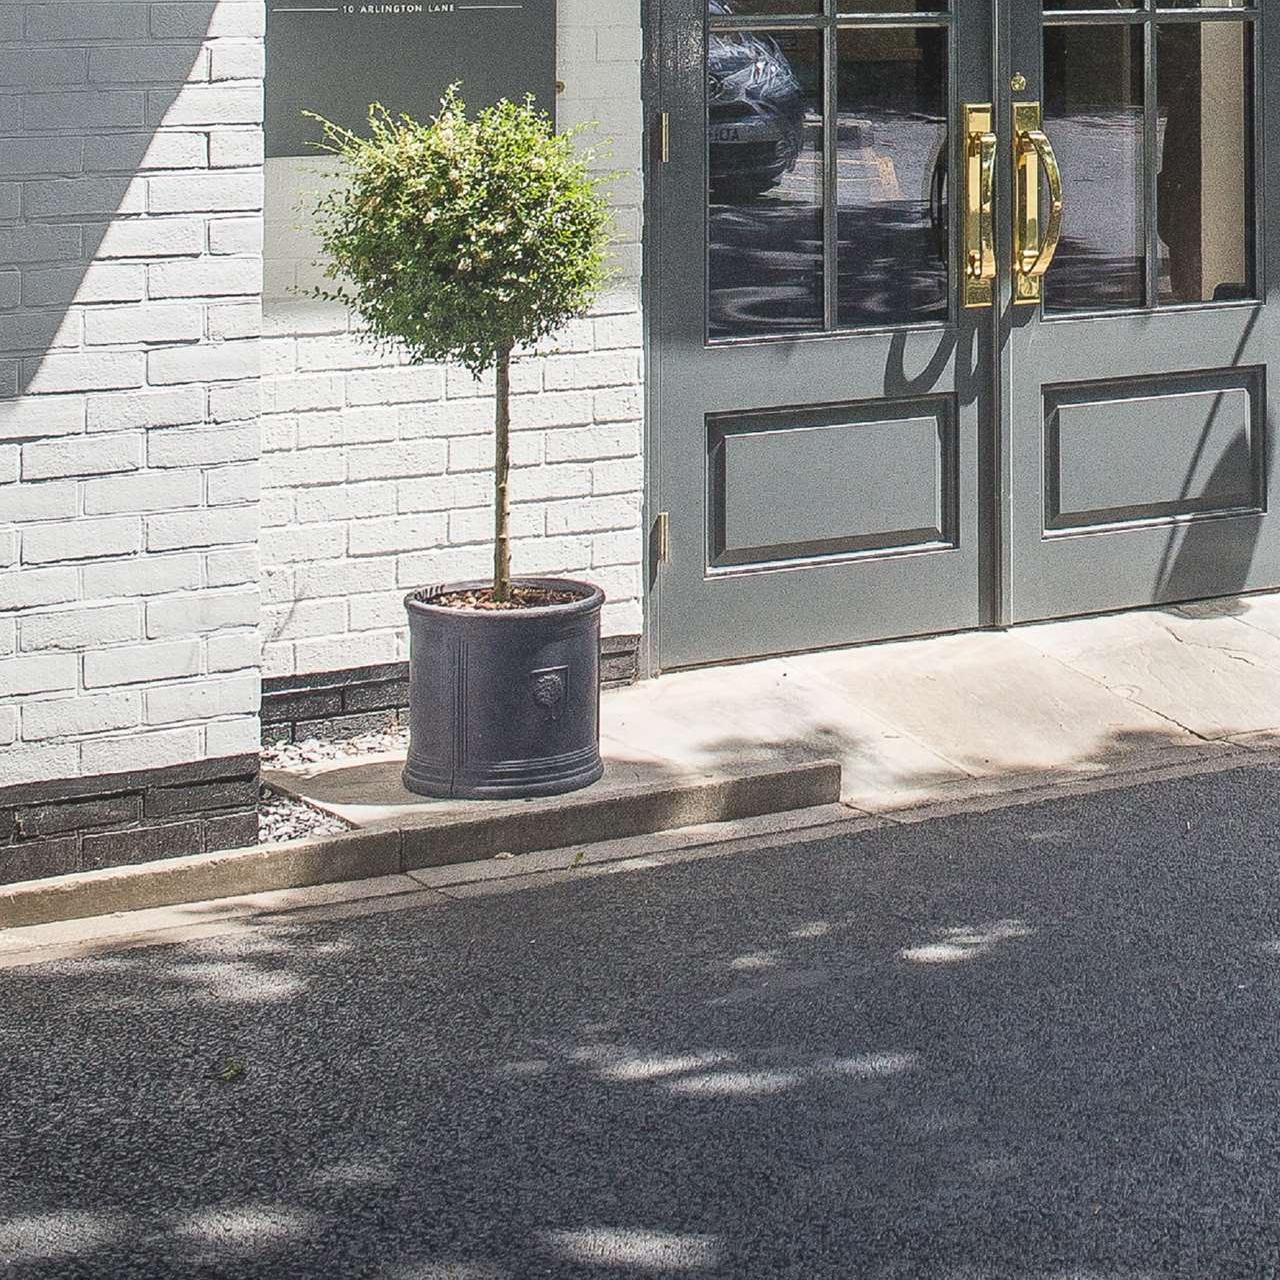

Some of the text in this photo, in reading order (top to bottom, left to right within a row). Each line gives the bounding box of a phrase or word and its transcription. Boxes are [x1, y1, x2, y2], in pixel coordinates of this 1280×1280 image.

[342, 4, 455, 14] 10 ARLINGTON LANE
